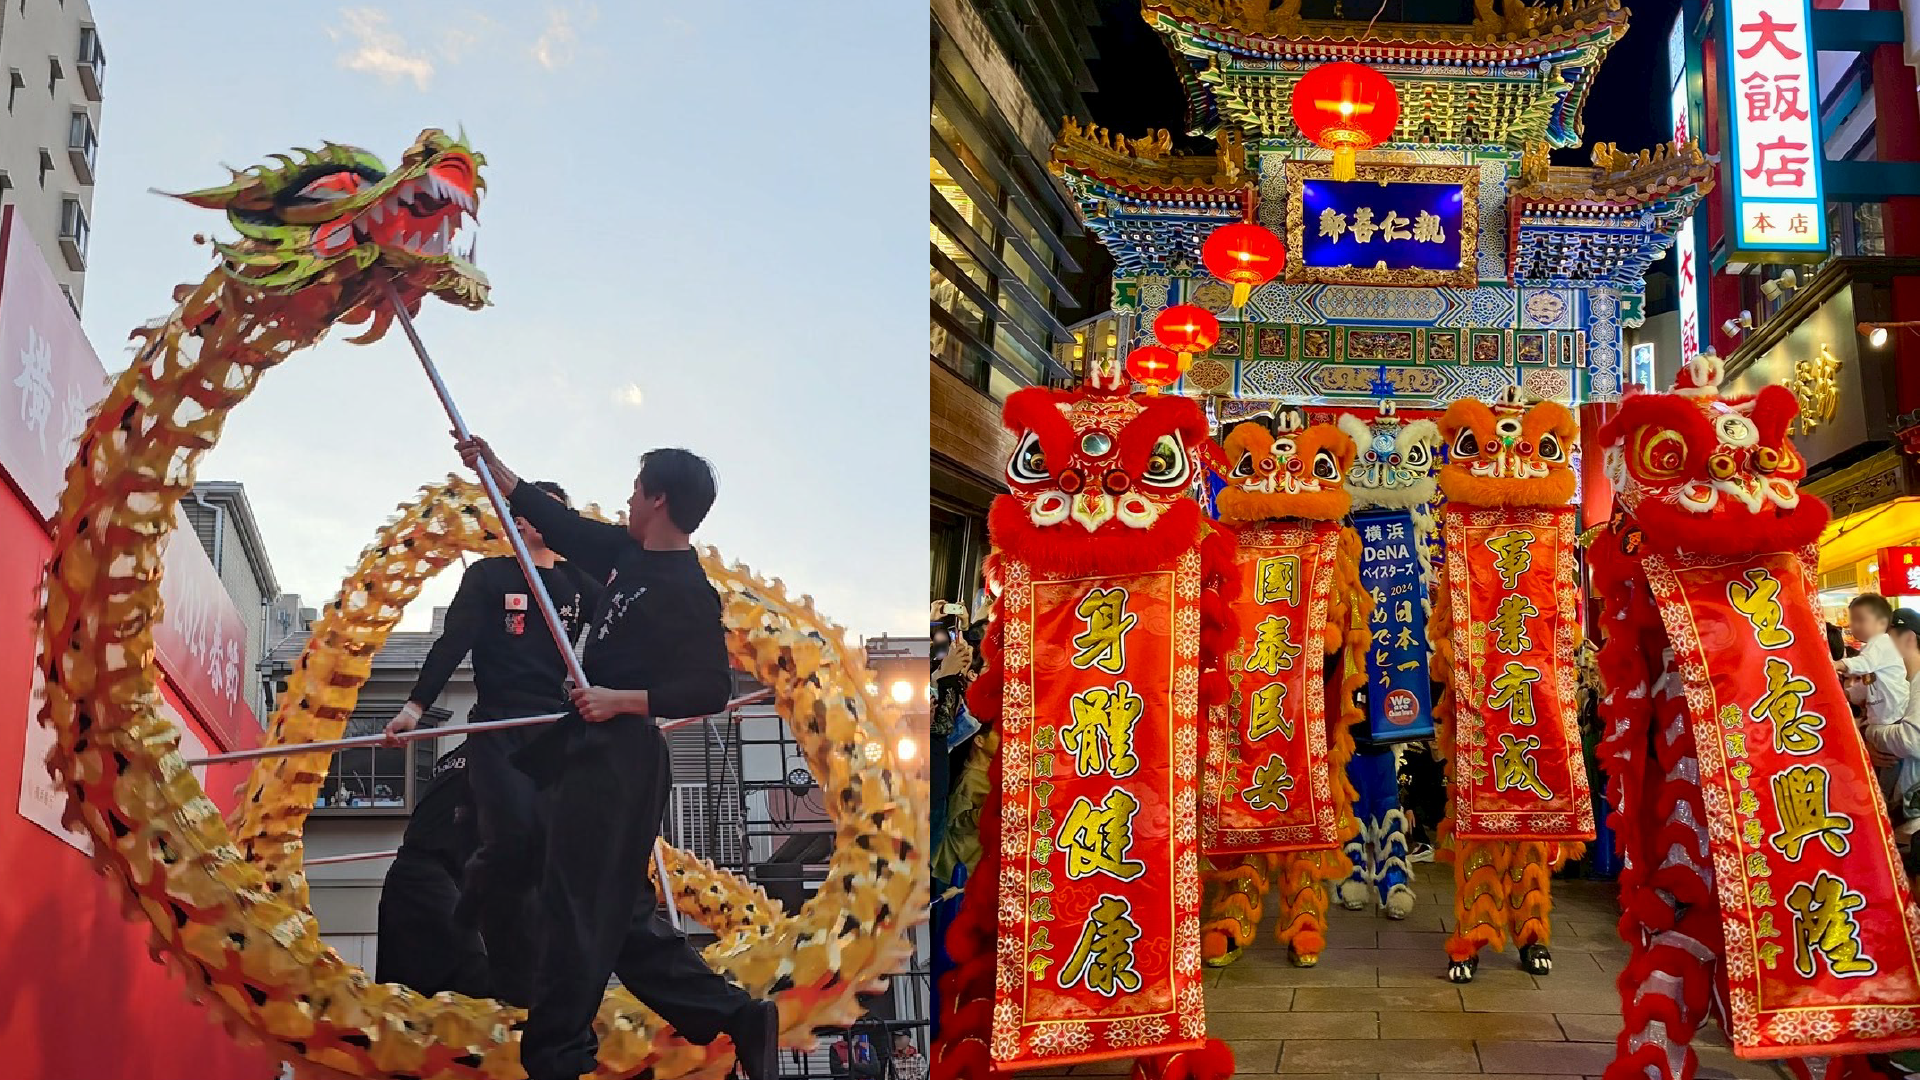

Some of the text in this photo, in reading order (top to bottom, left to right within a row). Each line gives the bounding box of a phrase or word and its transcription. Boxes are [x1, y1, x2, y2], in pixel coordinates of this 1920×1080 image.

[1736, 10, 1810, 188] 大飯店
[1751, 212, 1809, 234] 本店
[1363, 544, 1411, 563] DeNA
[1364, 523, 1405, 543] 横浜
[1362, 562, 1415, 580] ベイスターズ
[1390, 582, 1414, 596] 2024
[1394, 600, 1420, 672] 日本一
[1242, 554, 1302, 811] 國泰民安
[1486, 530, 1553, 801] 事業有成
[1390, 695, 1411, 705] We
[1056, 586, 1145, 997] 身體健康
[1727, 568, 1877, 978] 生意興隆
